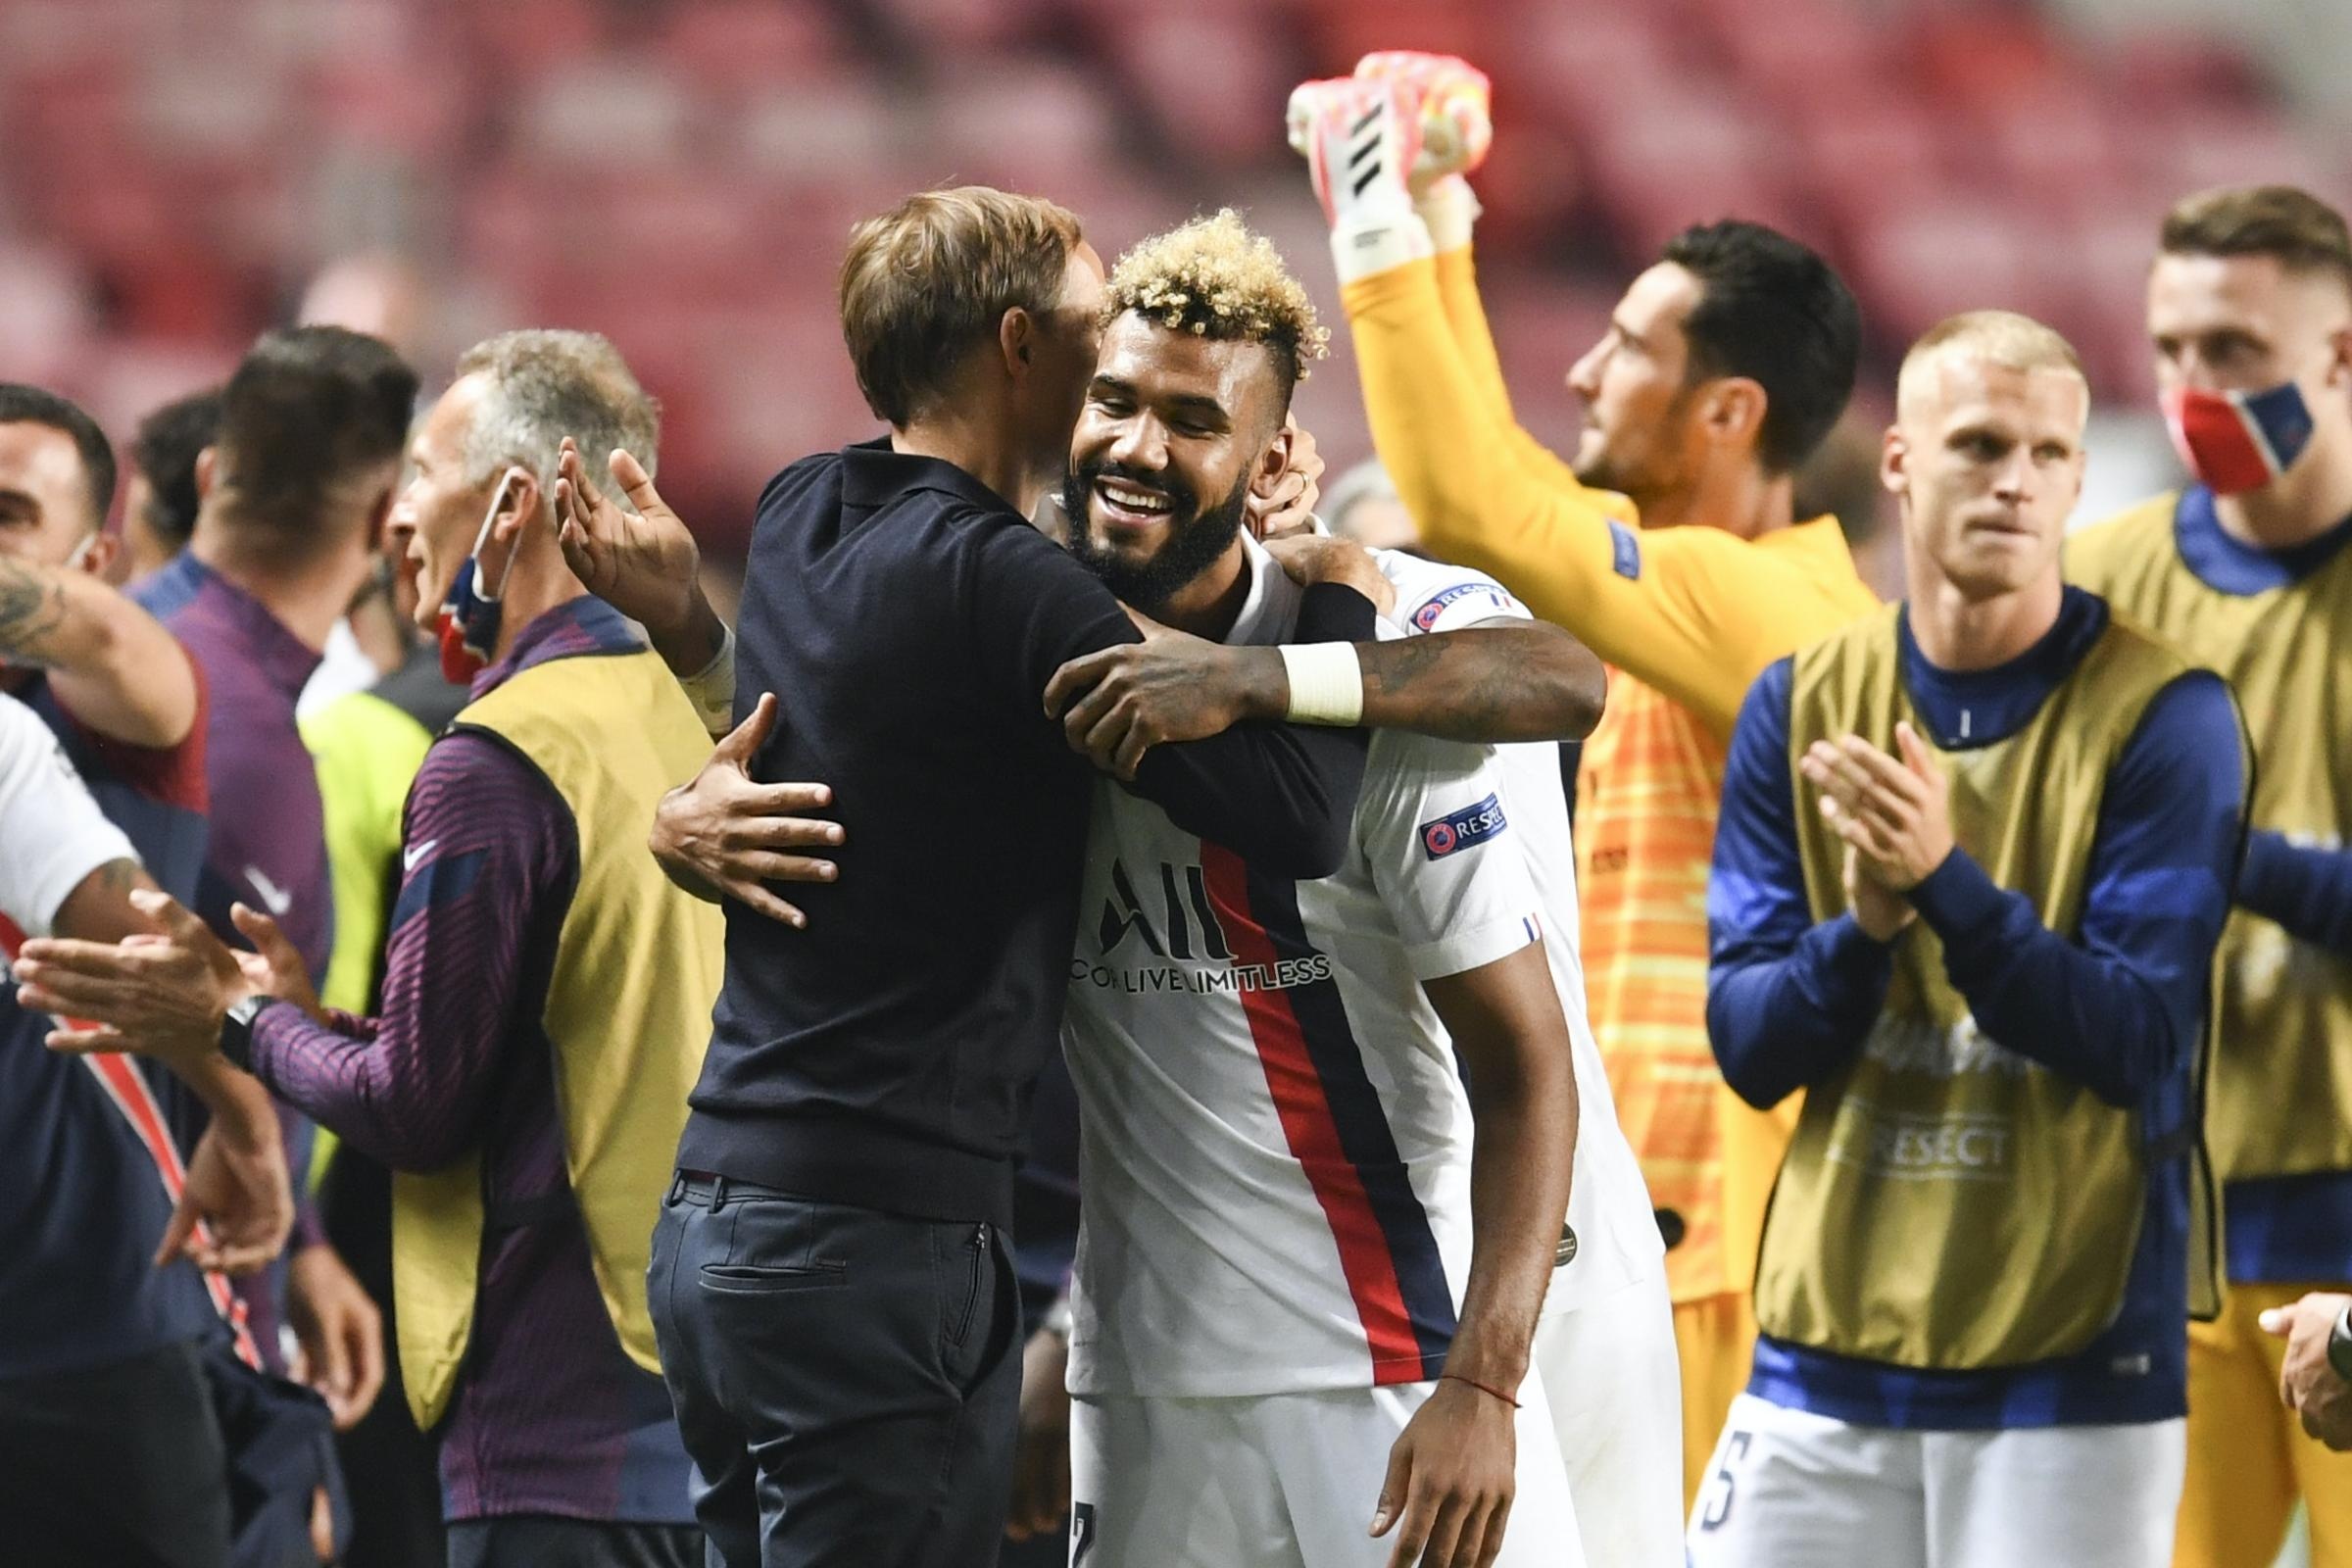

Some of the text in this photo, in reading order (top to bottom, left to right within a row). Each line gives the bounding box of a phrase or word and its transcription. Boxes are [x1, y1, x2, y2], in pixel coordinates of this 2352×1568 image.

[1456, 804, 1503, 839] RESPEC
[1123, 966, 1184, 994] LIVE
[1701, 1430, 1752, 1531] 5
